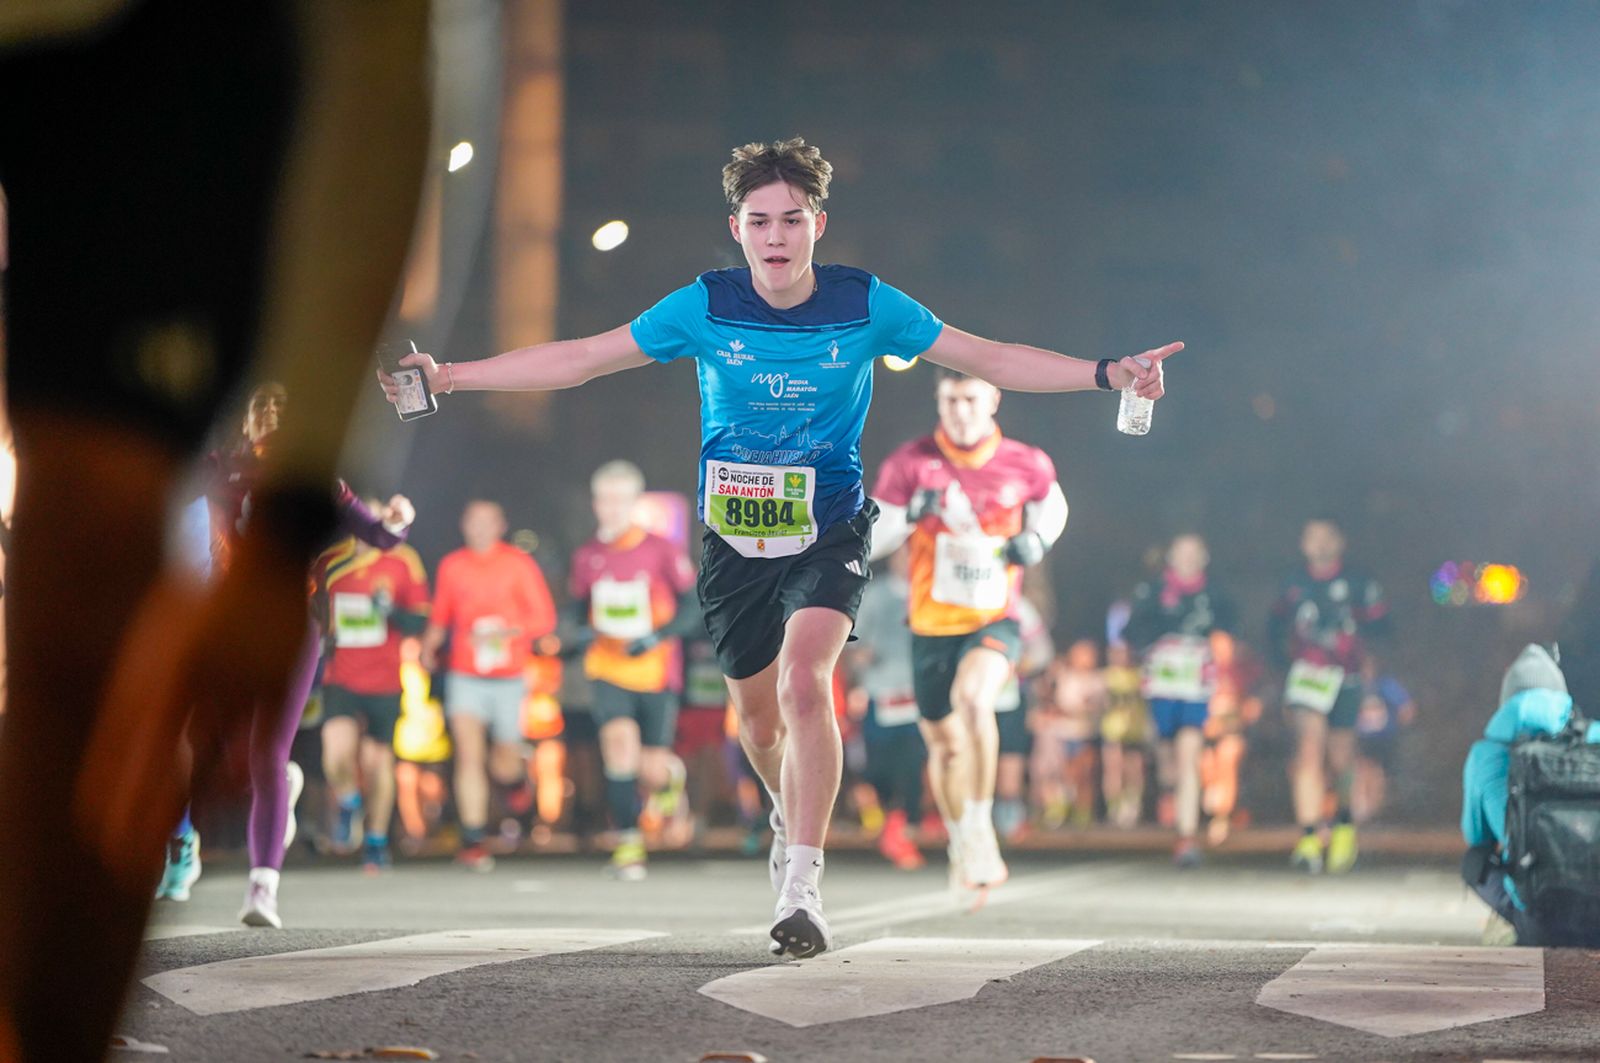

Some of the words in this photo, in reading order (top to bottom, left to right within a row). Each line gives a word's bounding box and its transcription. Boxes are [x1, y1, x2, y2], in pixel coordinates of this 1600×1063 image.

[730, 474, 759, 485] NOCHE
[762, 476, 774, 485] DE
[718, 484, 739, 495] SAN
[740, 486, 774, 497] ANTÓN
[726, 498, 795, 527] 8984
